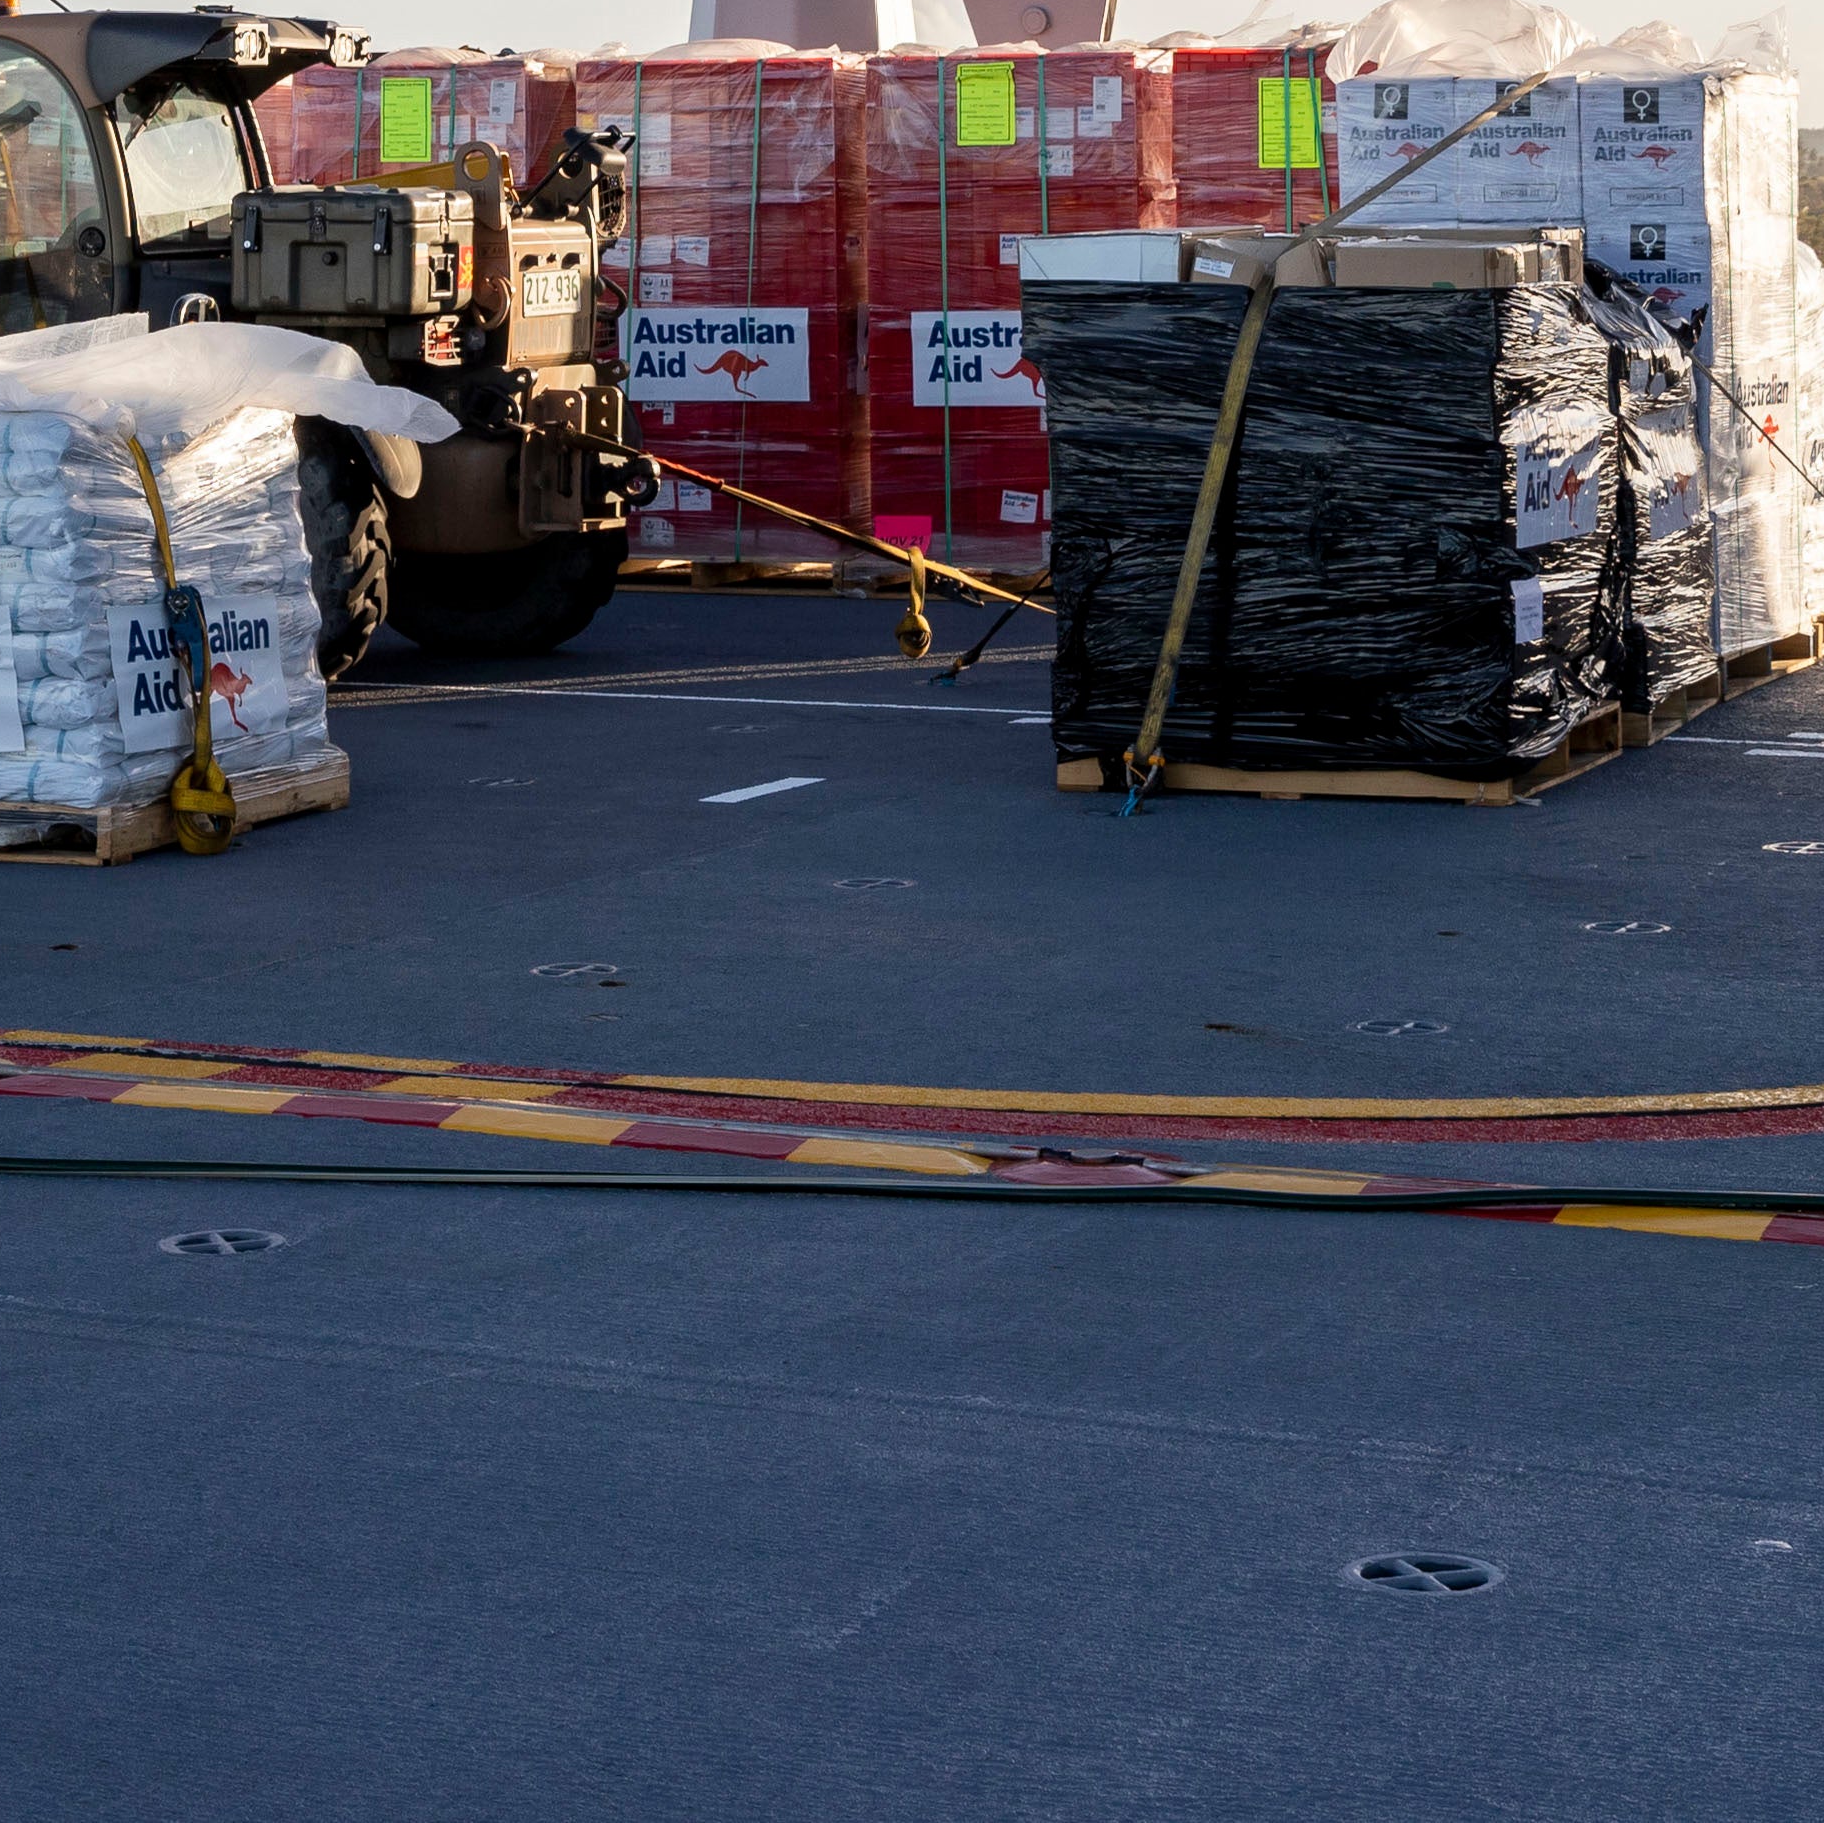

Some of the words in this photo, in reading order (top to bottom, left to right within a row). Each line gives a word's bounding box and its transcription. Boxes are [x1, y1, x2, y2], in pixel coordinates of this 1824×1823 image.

[1593, 125, 1693, 144] Australian
[1469, 142, 1500, 159] Aid
[1594, 146, 1626, 162] Aid
[1623, 268, 1702, 284] stralian
[633, 316, 795, 345] Australian
[927, 318, 1024, 348] Austr
[634, 350, 686, 379] Aid
[928, 355, 982, 384] Aid
[1523, 469, 1552, 513] Aid
[127, 610, 270, 663] Aualian
[133, 669, 186, 716] Aid
